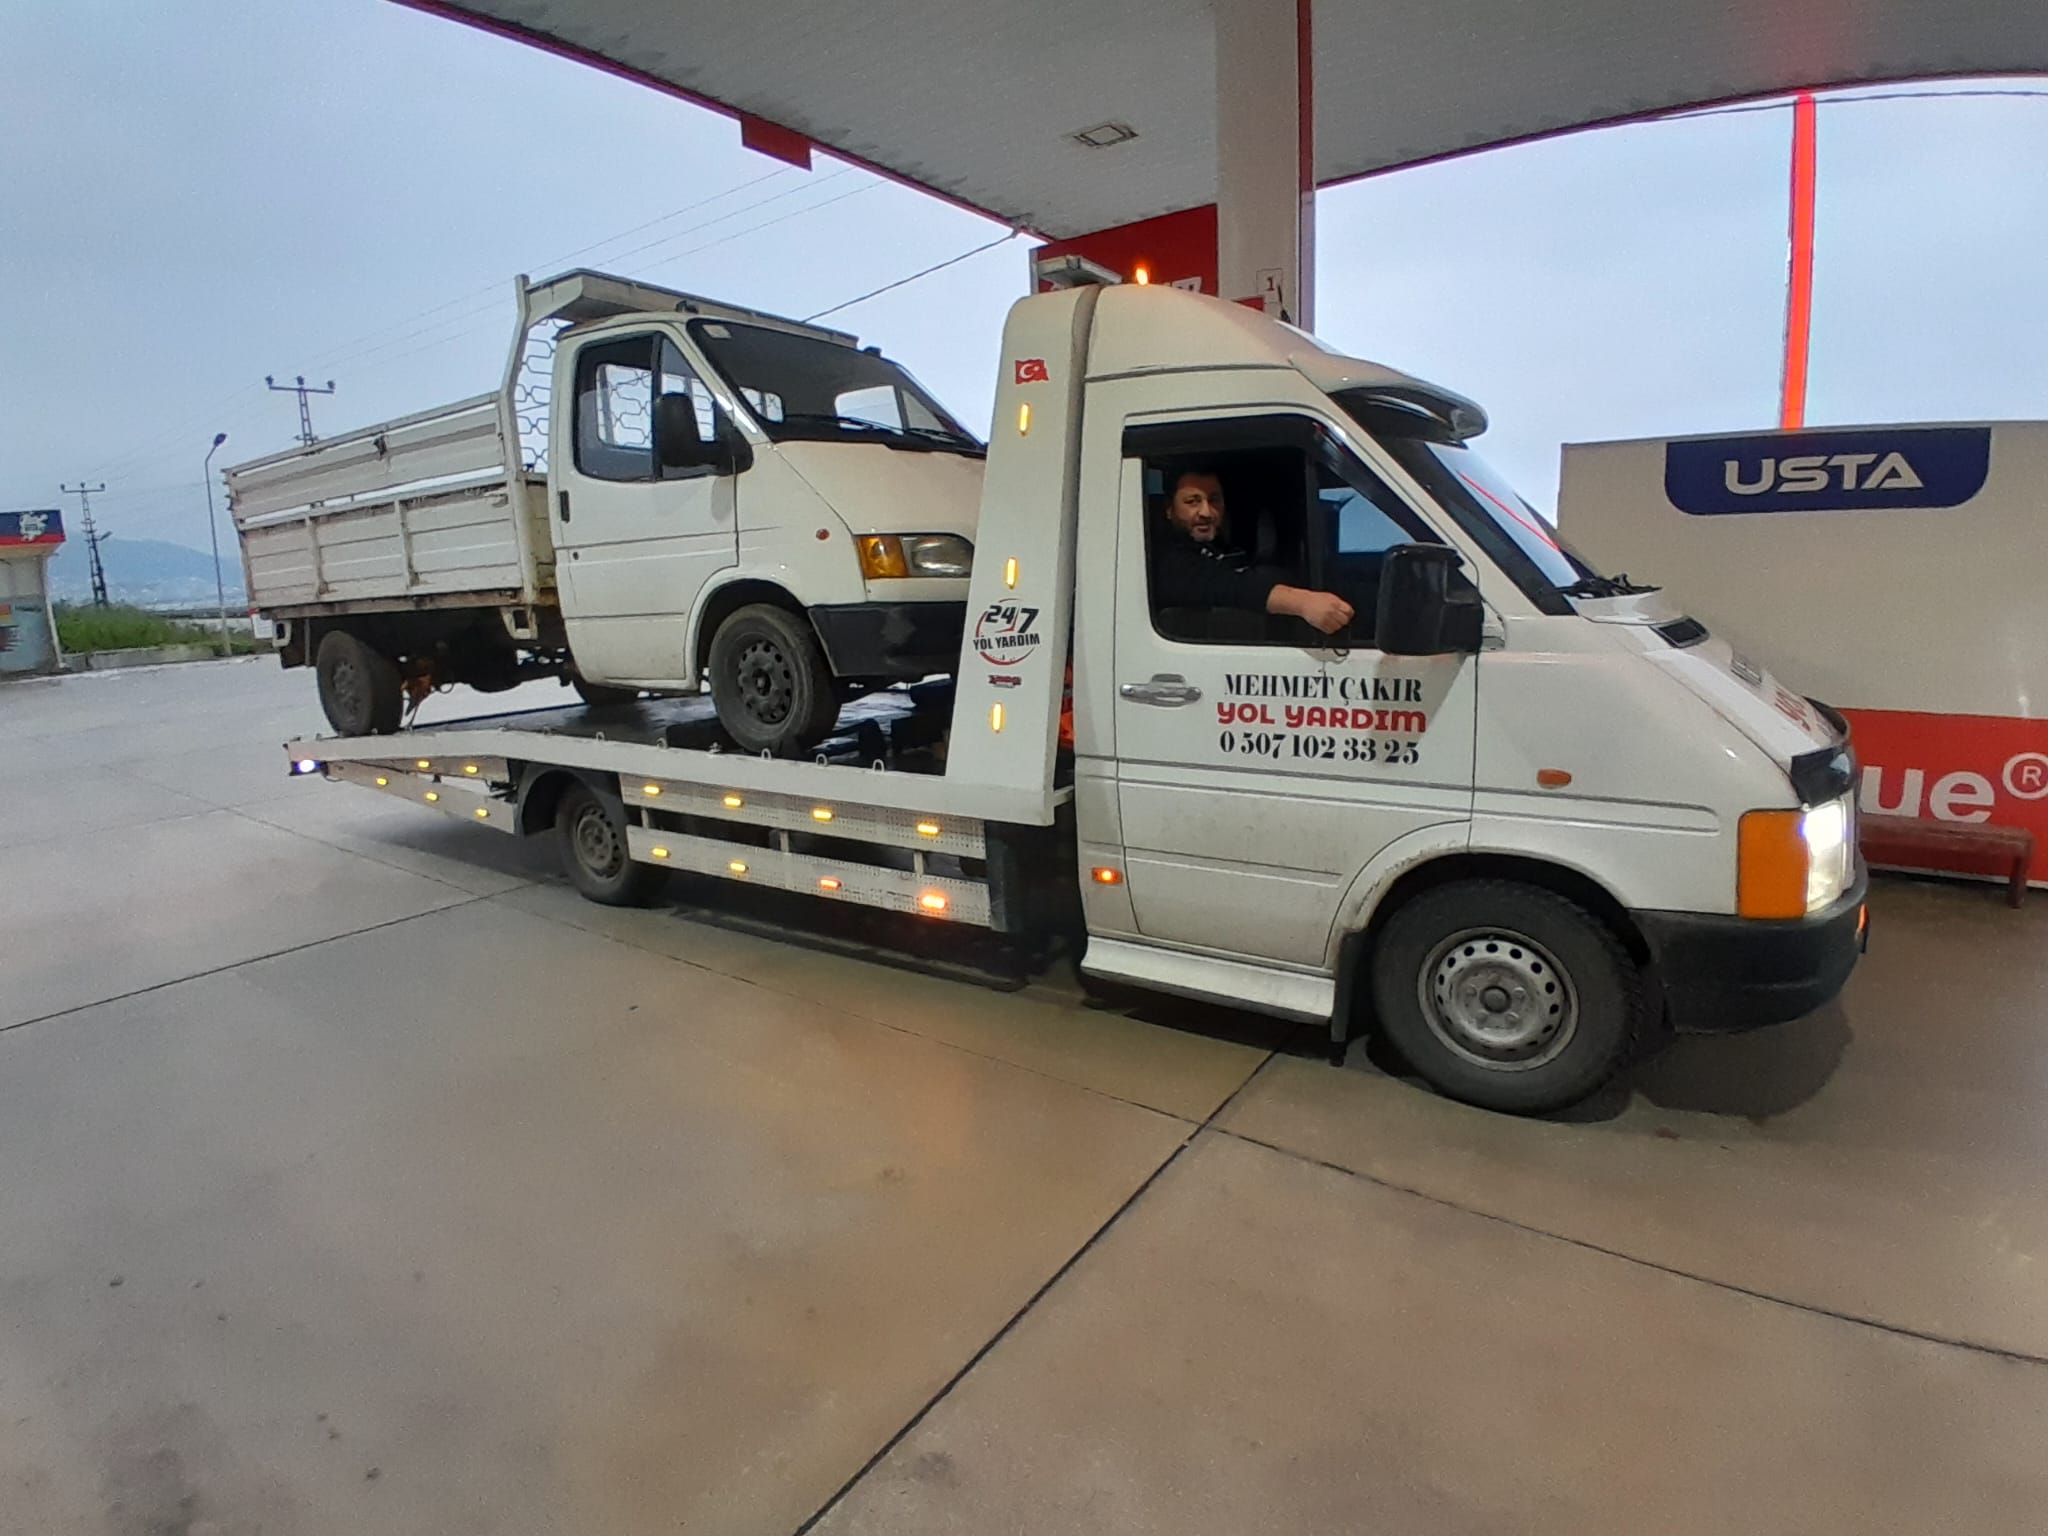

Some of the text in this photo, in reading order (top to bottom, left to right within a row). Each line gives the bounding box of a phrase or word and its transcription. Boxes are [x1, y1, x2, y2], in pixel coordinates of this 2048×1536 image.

[1724, 451, 1924, 495] USTA
[973, 632, 1041, 651] YOL YARDIM
[1224, 673, 1423, 706] MEHMET ÇAKIR
[1217, 701, 1427, 733] YOL YARDIM
[1220, 730, 1420, 765] 0 507 102 33 25
